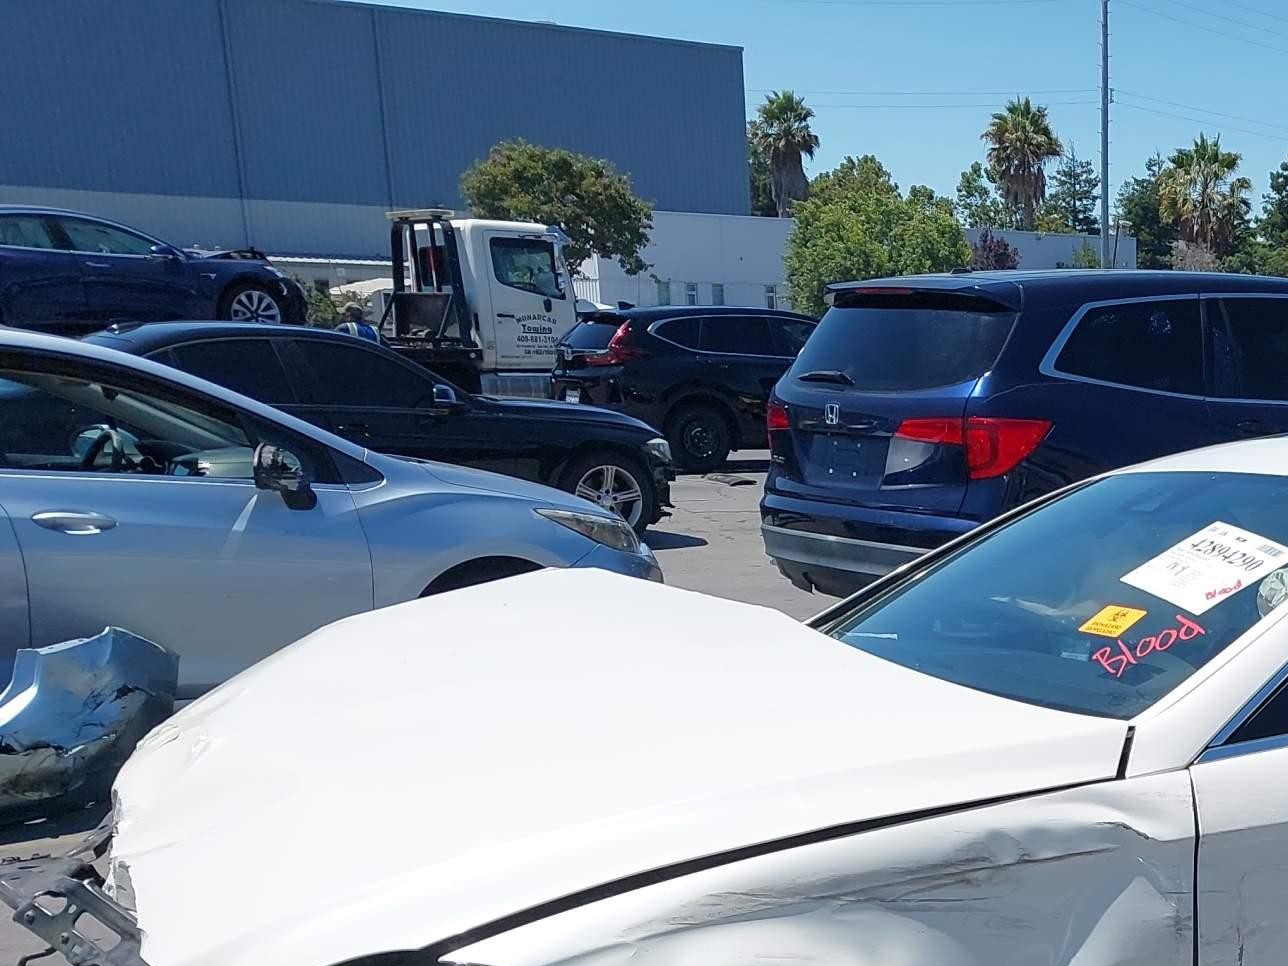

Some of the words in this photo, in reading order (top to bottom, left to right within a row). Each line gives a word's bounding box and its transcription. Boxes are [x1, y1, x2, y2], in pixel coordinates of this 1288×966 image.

[522, 324, 552, 334] Towing
[1191, 538, 1265, 572] 42894290
[1091, 614, 1206, 677] Blood
